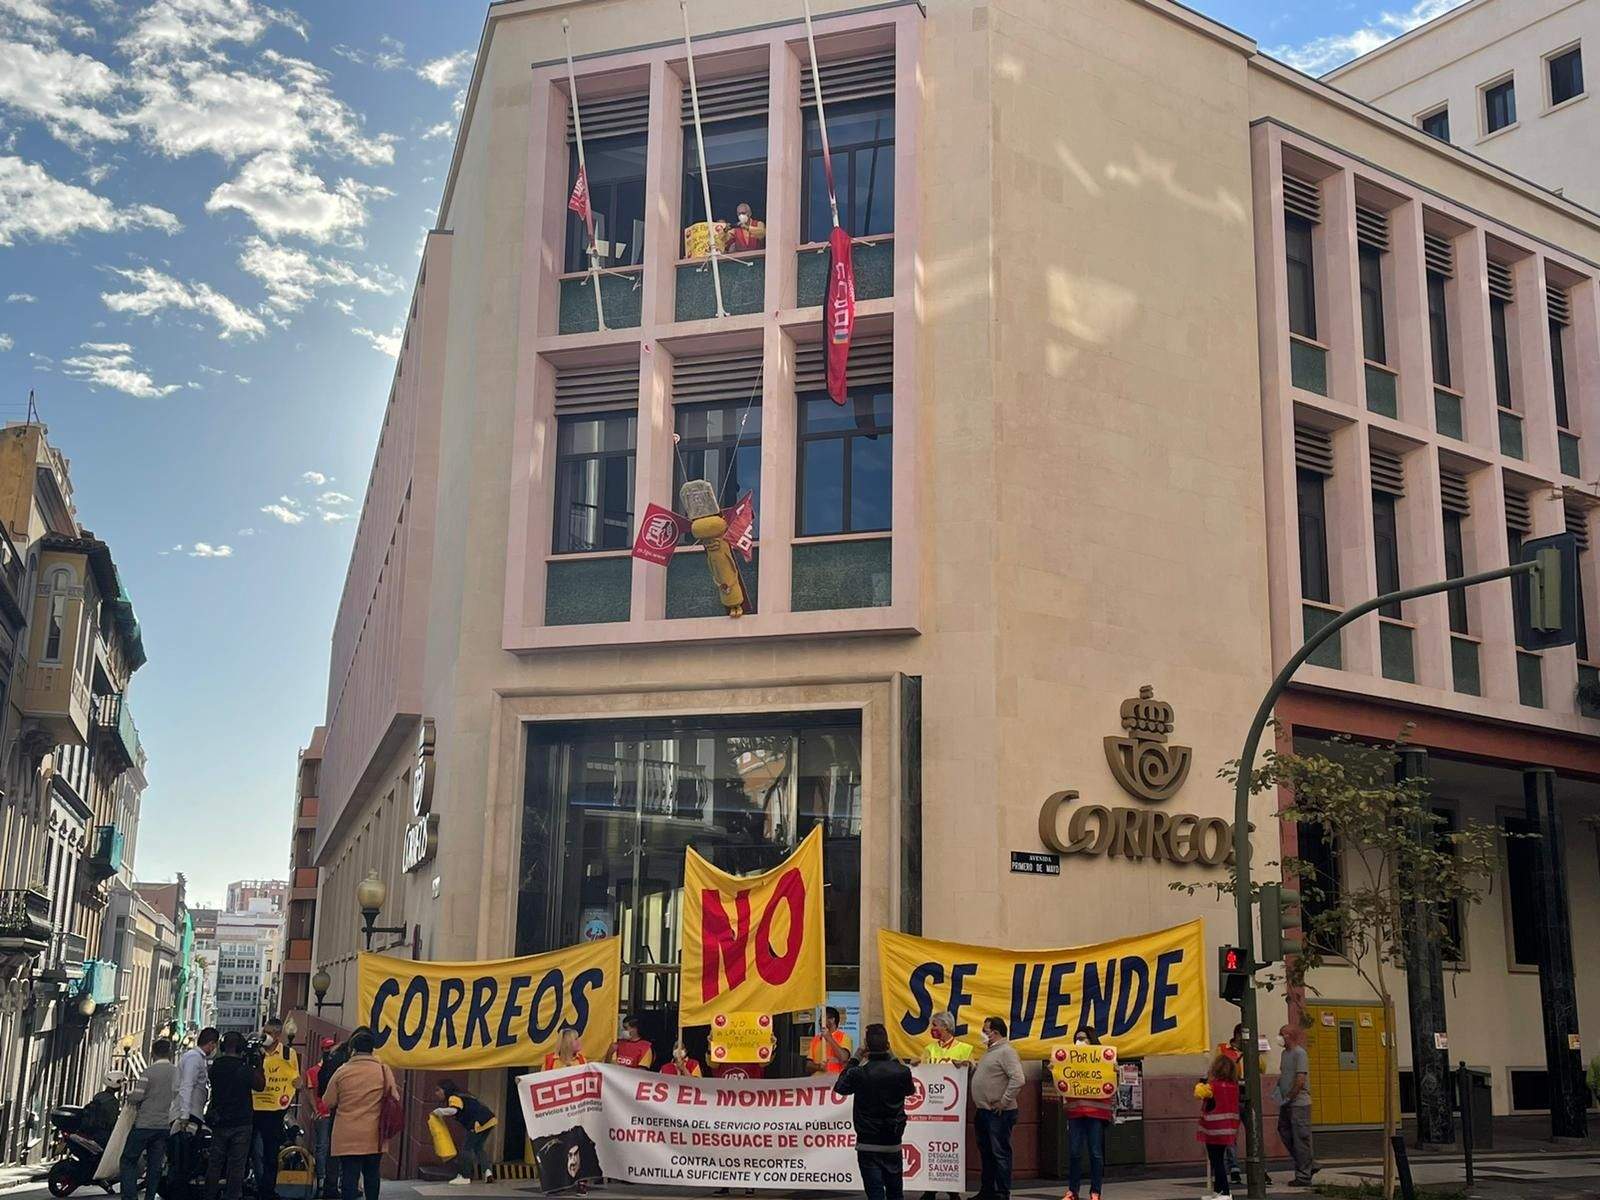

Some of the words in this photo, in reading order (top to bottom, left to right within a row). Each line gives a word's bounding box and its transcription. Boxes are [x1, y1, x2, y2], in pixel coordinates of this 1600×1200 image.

[1011, 861, 1033, 872] PRIMERO
[1036, 863, 1043, 872] DE
[1046, 864, 1060, 873] MAYO
[1029, 855, 1052, 863] AVENIDA
[701, 867, 806, 1005] NO
[900, 962, 978, 1037] SE
[1008, 948, 1184, 1041] VENDE
[370, 967, 604, 1051] CORREOS
[536, 1076, 599, 1106] CCOO
[635, 1081, 669, 1103] ES
[676, 1085, 707, 1106] EL
[716, 1086, 848, 1107] MOMENTO
[631, 1116, 644, 1126] EN
[646, 1117, 689, 1129] DEFENSA
[691, 1119, 711, 1130] DEL
[713, 1121, 760, 1131] SERVICIO
[763, 1121, 803, 1131] POSTAL
[805, 1119, 852, 1131] PÚBLICO
[608, 1128, 666, 1144] CONTRA
[670, 1131, 687, 1146] EL
[692, 1132, 773, 1148] DESGUACE
[778, 1134, 798, 1148] DE
[928, 1141, 959, 1153] STOP
[671, 1155, 716, 1167] CONTRA
[719, 1158, 740, 1168] LOS
[743, 1158, 807, 1170] RECORTES,
[928, 1163, 959, 1173] SALVAR
[628, 1166, 684, 1179] PLANTILLA
[687, 1169, 751, 1181] SUFICIENTE
[753, 1172, 762, 1181] Y
[763, 1172, 787, 1182] CON
[790, 1172, 853, 1183] DERECHOS
